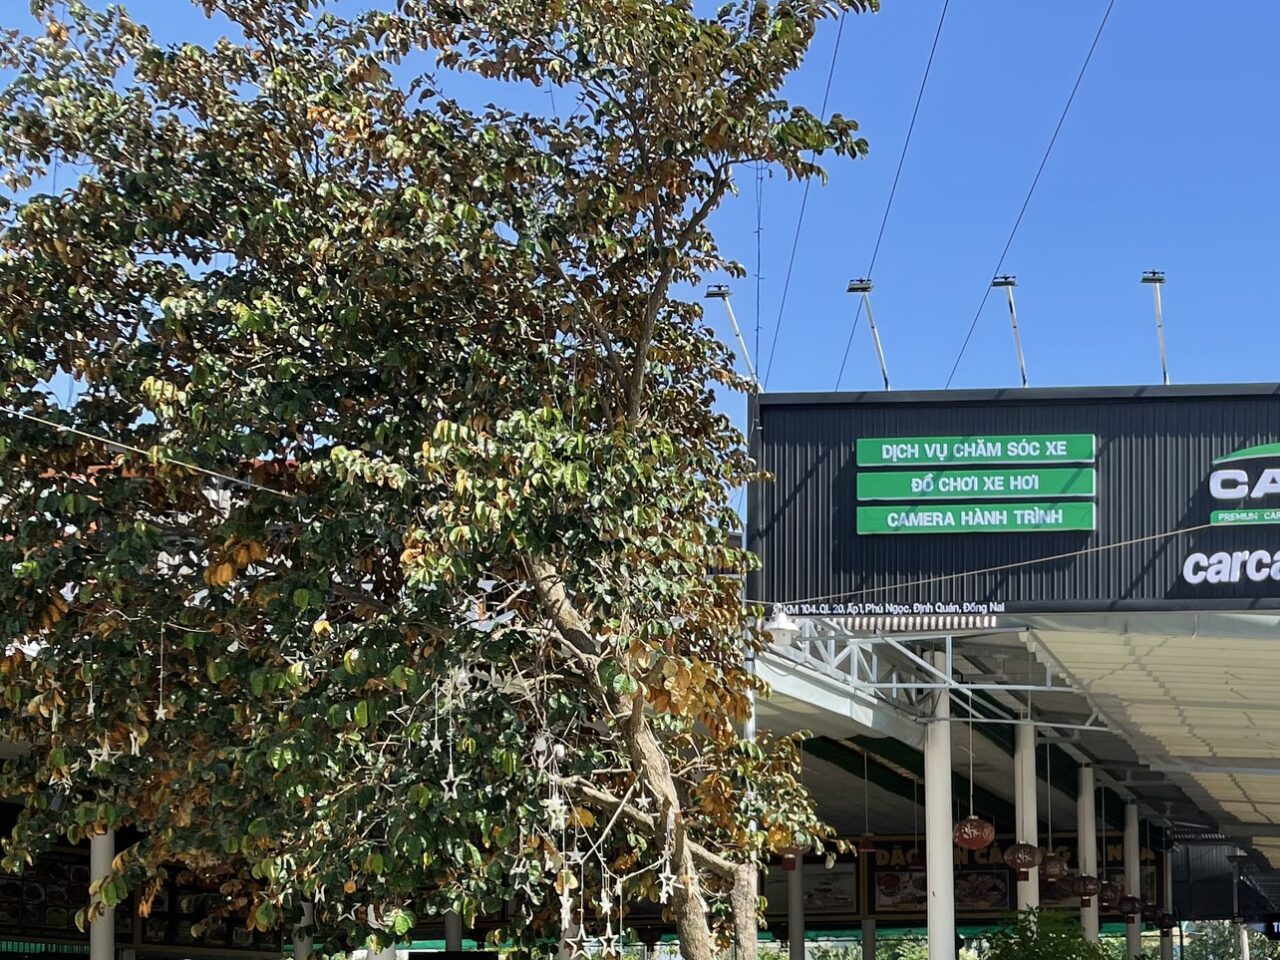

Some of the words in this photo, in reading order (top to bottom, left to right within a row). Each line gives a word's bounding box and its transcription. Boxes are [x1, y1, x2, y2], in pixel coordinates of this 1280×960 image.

[881, 443, 919, 462] DỊCH
[924, 443, 948, 461] VỤ
[952, 439, 1002, 459] CHĂM
[1007, 438, 1041, 456] SÓC
[1045, 441, 1068, 456] XE
[910, 473, 934, 493] ĐỒ
[938, 476, 979, 491] CHƠI
[983, 476, 1005, 491] XE
[1009, 474, 1040, 490] HƠI
[887, 511, 956, 528] CAMERA
[960, 508, 1008, 526] HÀNH
[1013, 506, 1064, 525] TRÌNH
[865, 603, 884, 614] Phú
[913, 602, 934, 615] Định
